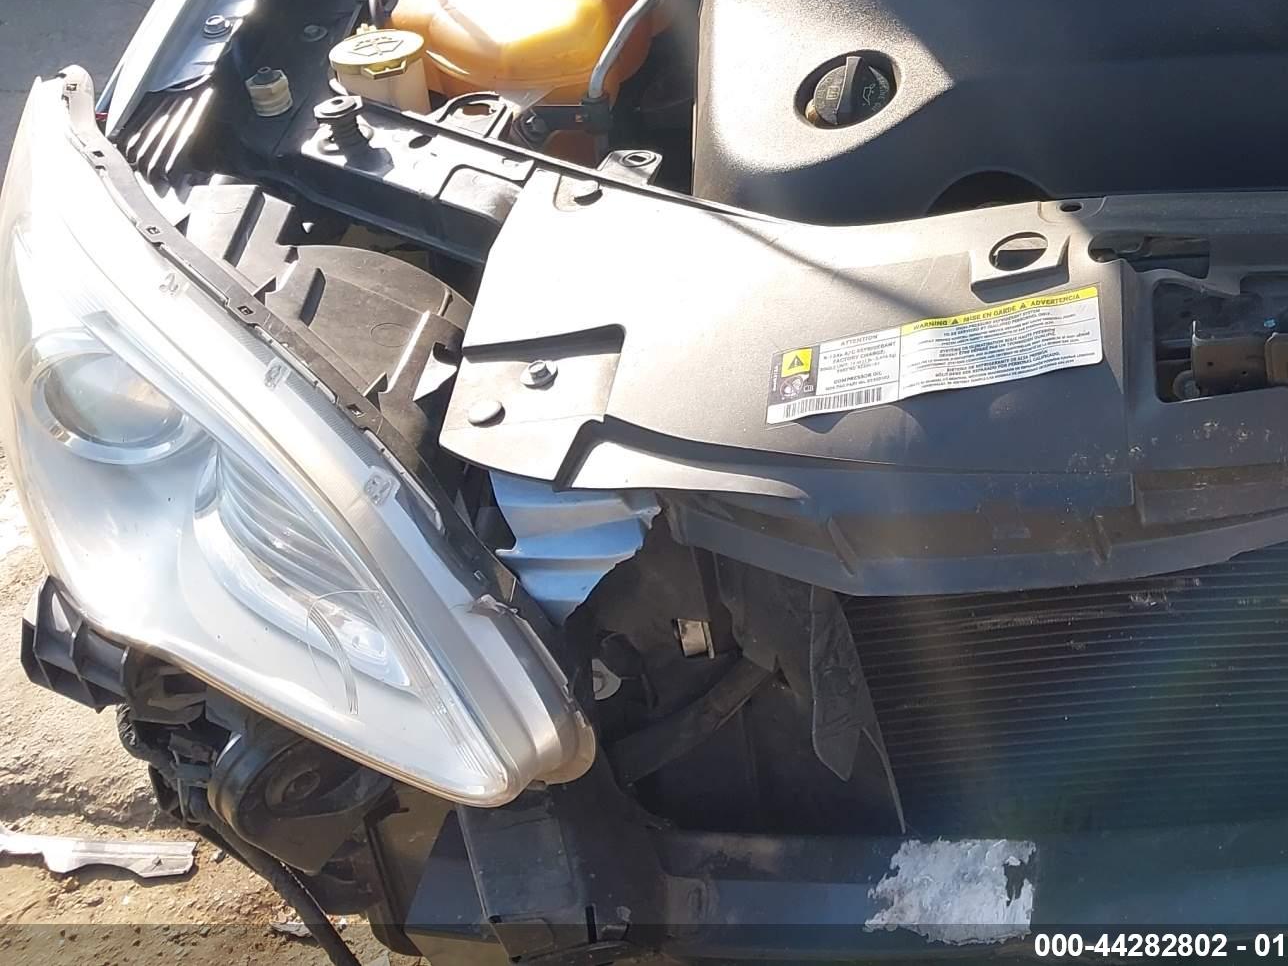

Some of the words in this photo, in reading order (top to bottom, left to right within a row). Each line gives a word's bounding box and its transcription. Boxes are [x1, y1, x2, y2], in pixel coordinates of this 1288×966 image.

[912, 320, 948, 331] WARNING
[962, 314, 981, 323] MISE
[982, 311, 993, 319] EN
[1030, 293, 1081, 306] ADVERTENCIA
[840, 335, 878, 346] ATTENTION
[832, 354, 859, 364] FACTORY
[833, 372, 872, 385] COMPRESSOR
